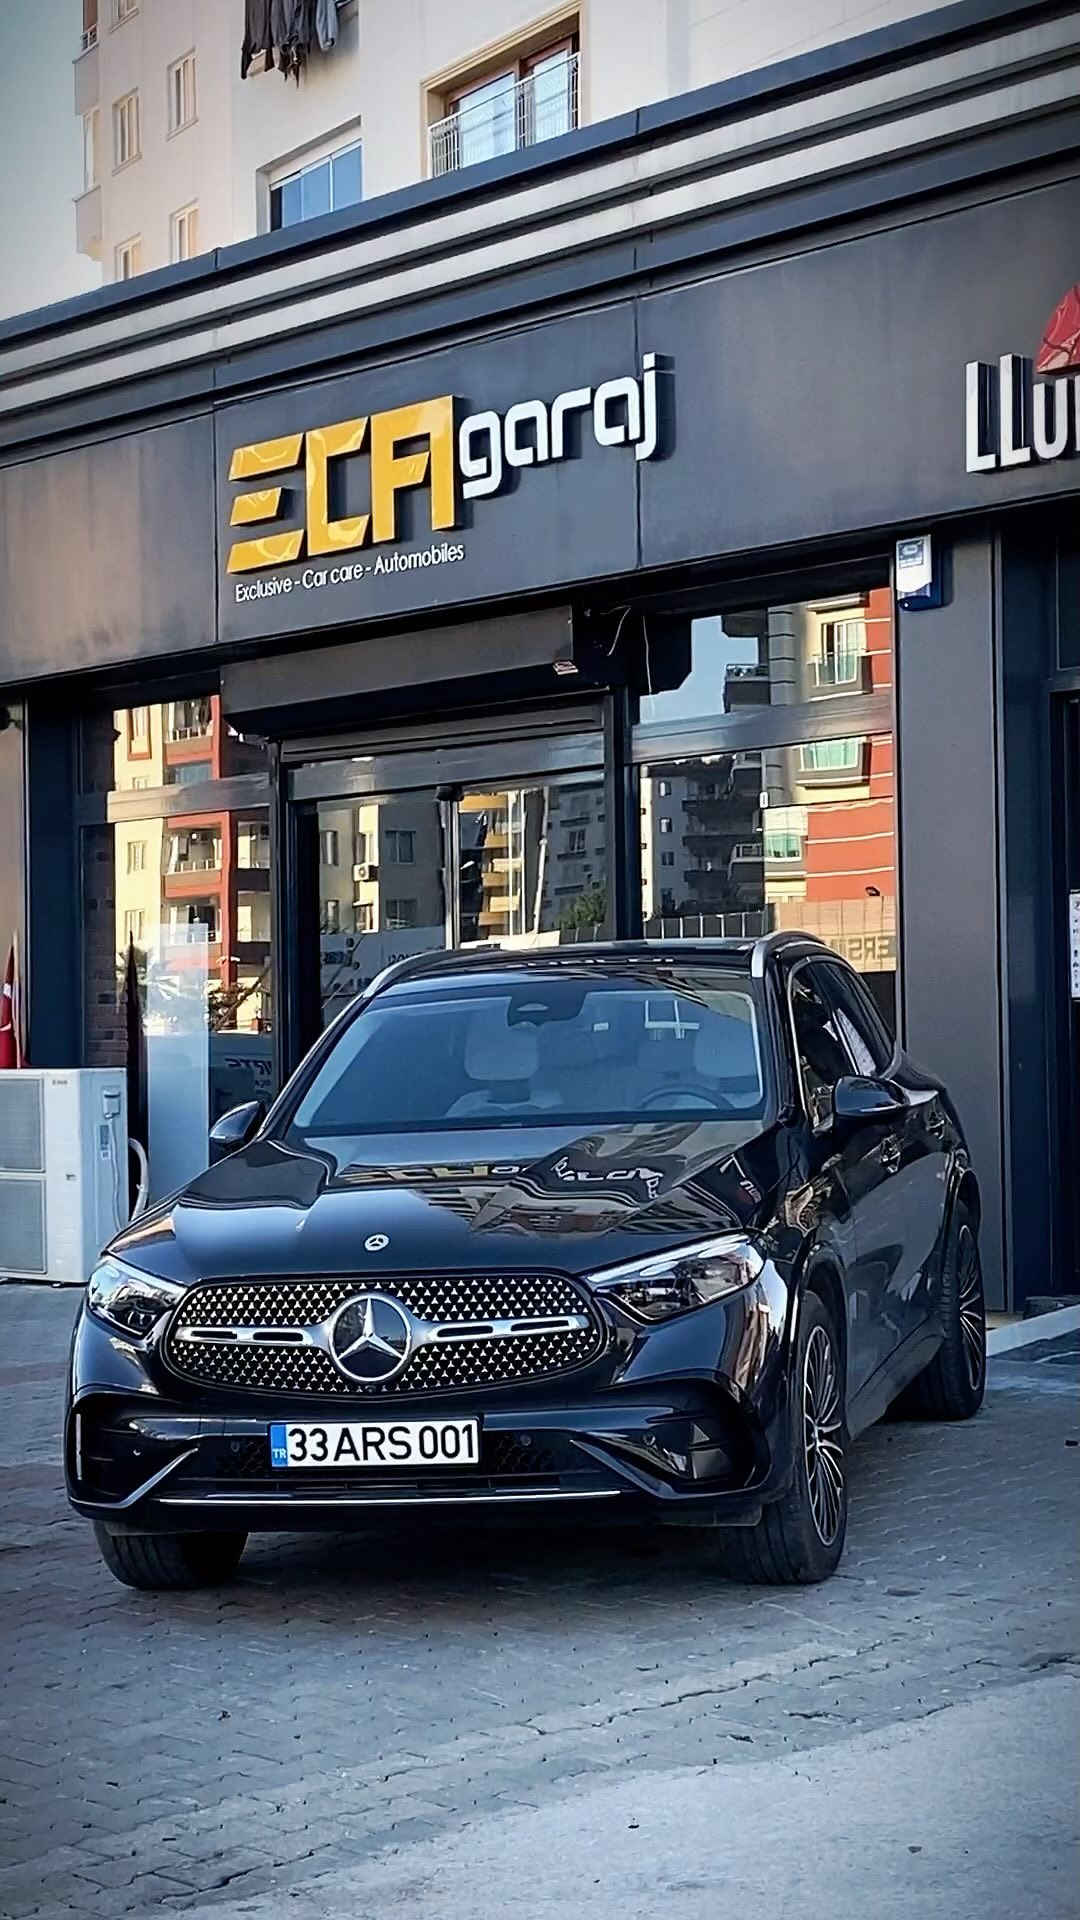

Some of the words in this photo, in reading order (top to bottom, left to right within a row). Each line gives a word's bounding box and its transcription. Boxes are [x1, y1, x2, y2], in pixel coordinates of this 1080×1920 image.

[458, 352, 657, 500] garaj
[965, 353, 1080, 473] LLU
[235, 576, 293, 602] Exclusive
[302, 569, 328, 589] Car
[329, 563, 364, 583] care
[373, 542, 465, 576] Automobiles
[272, 1449, 288, 1460] TR
[288, 1427, 329, 1462] 33
[333, 1425, 412, 1462] ARS
[418, 1423, 475, 1460] 001
